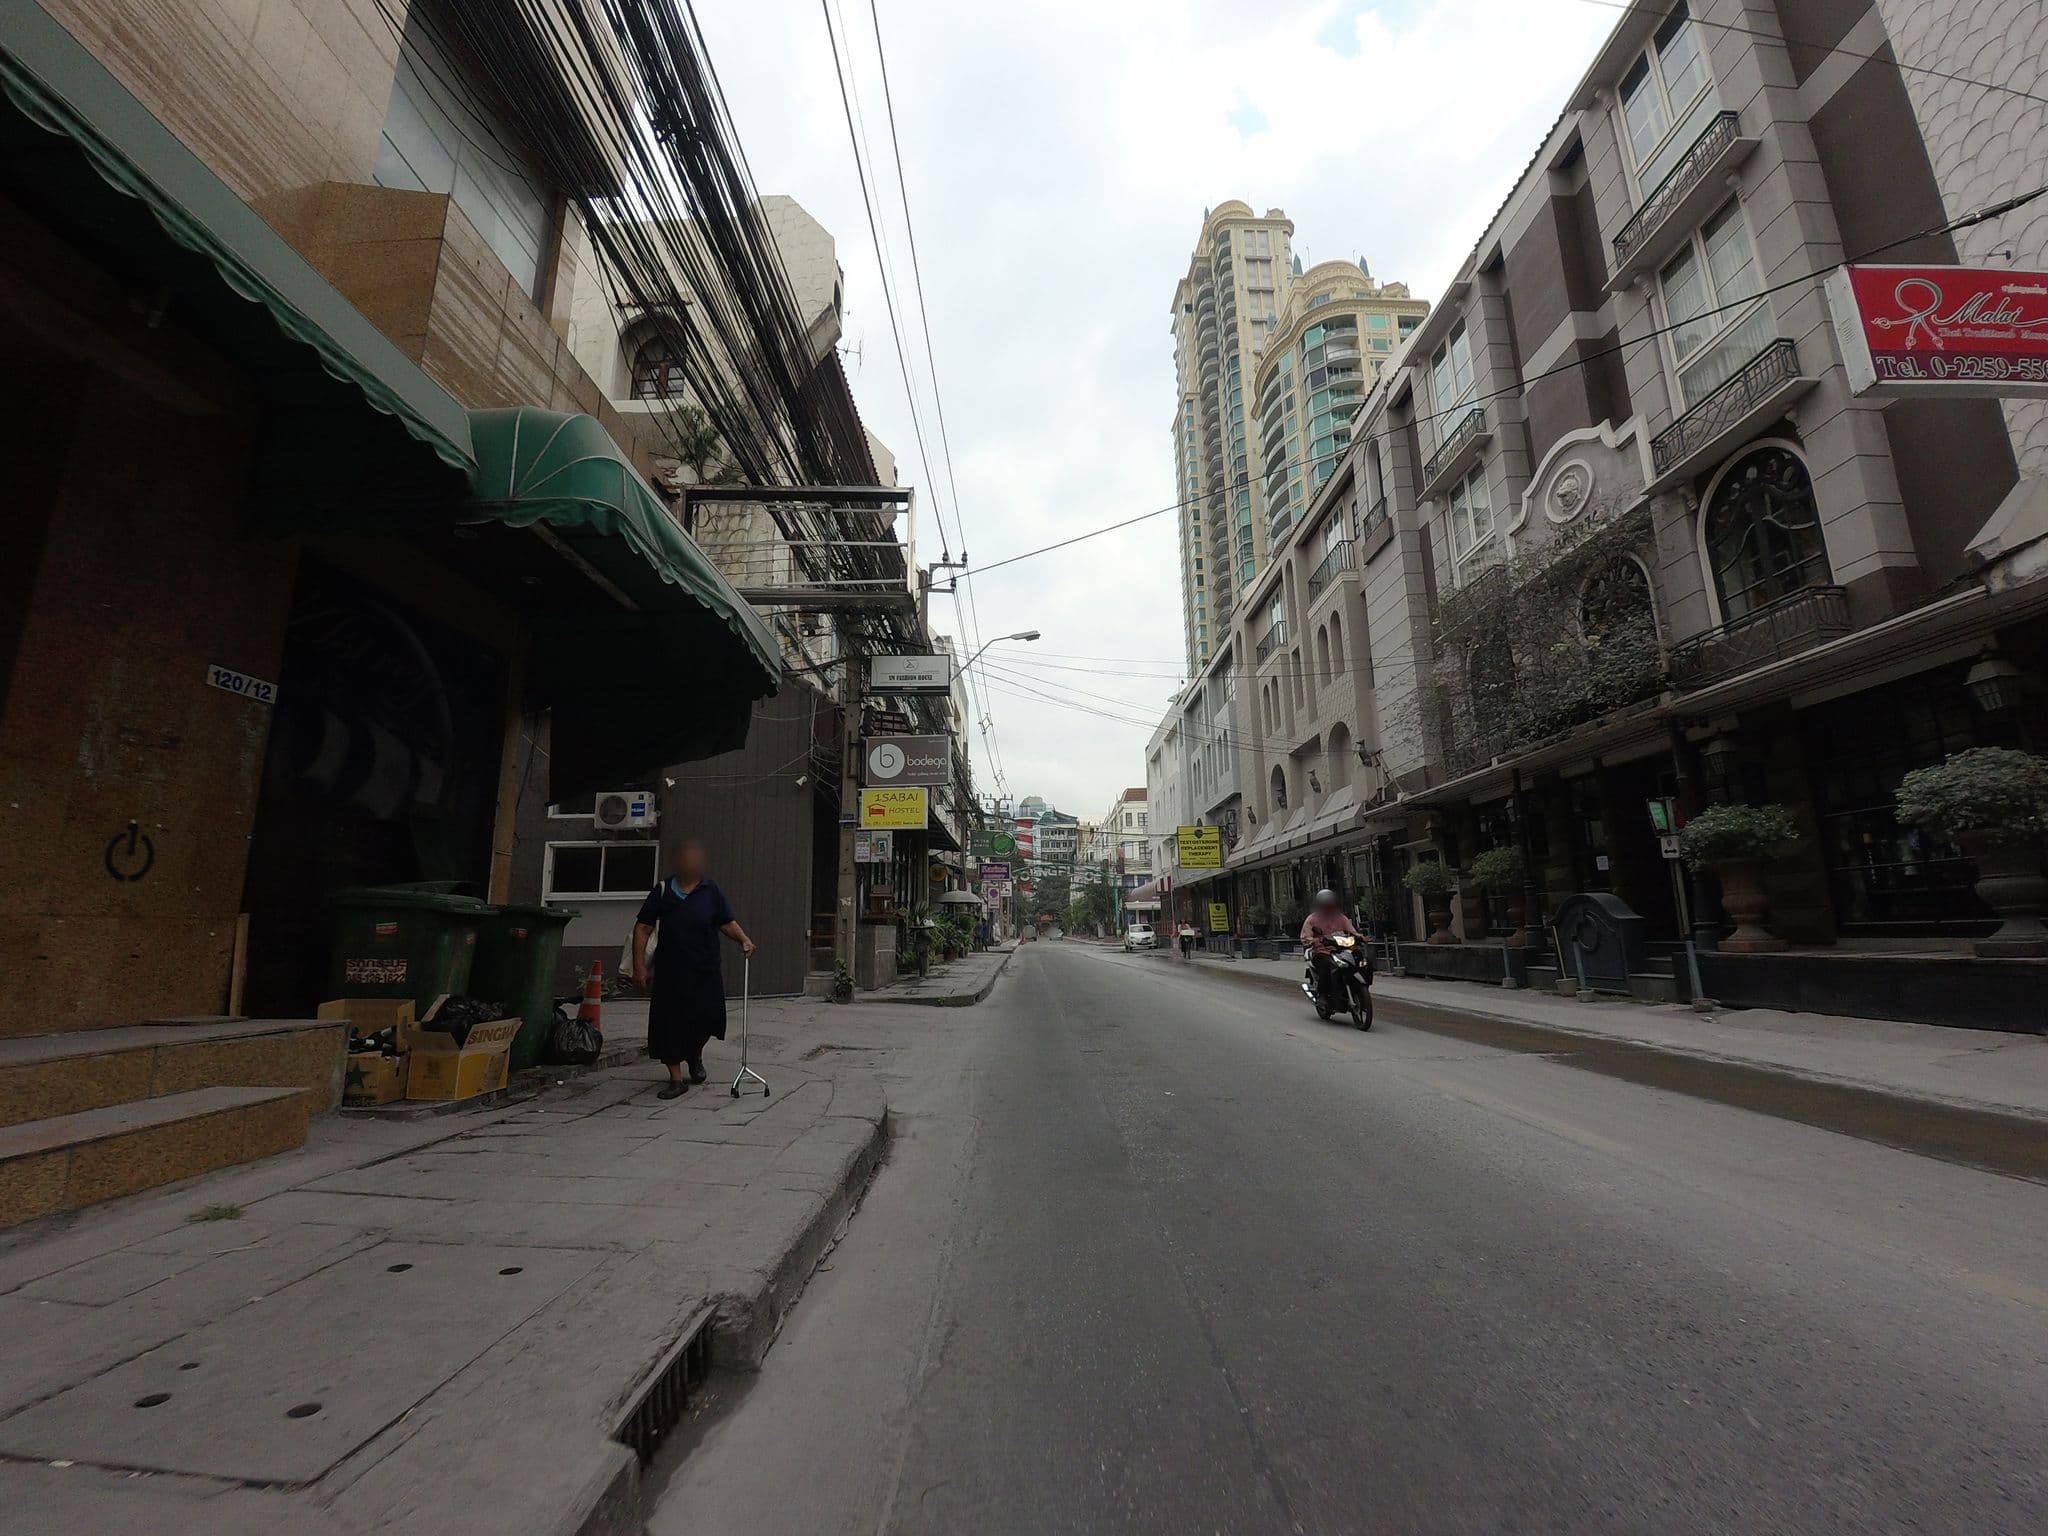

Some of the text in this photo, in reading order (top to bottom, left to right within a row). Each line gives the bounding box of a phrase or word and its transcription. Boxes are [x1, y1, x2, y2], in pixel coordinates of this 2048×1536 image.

[1931, 292, 2048, 327] Malai
[1877, 356, 1927, 378] Tel.
[214, 670, 272, 699] 120/12
